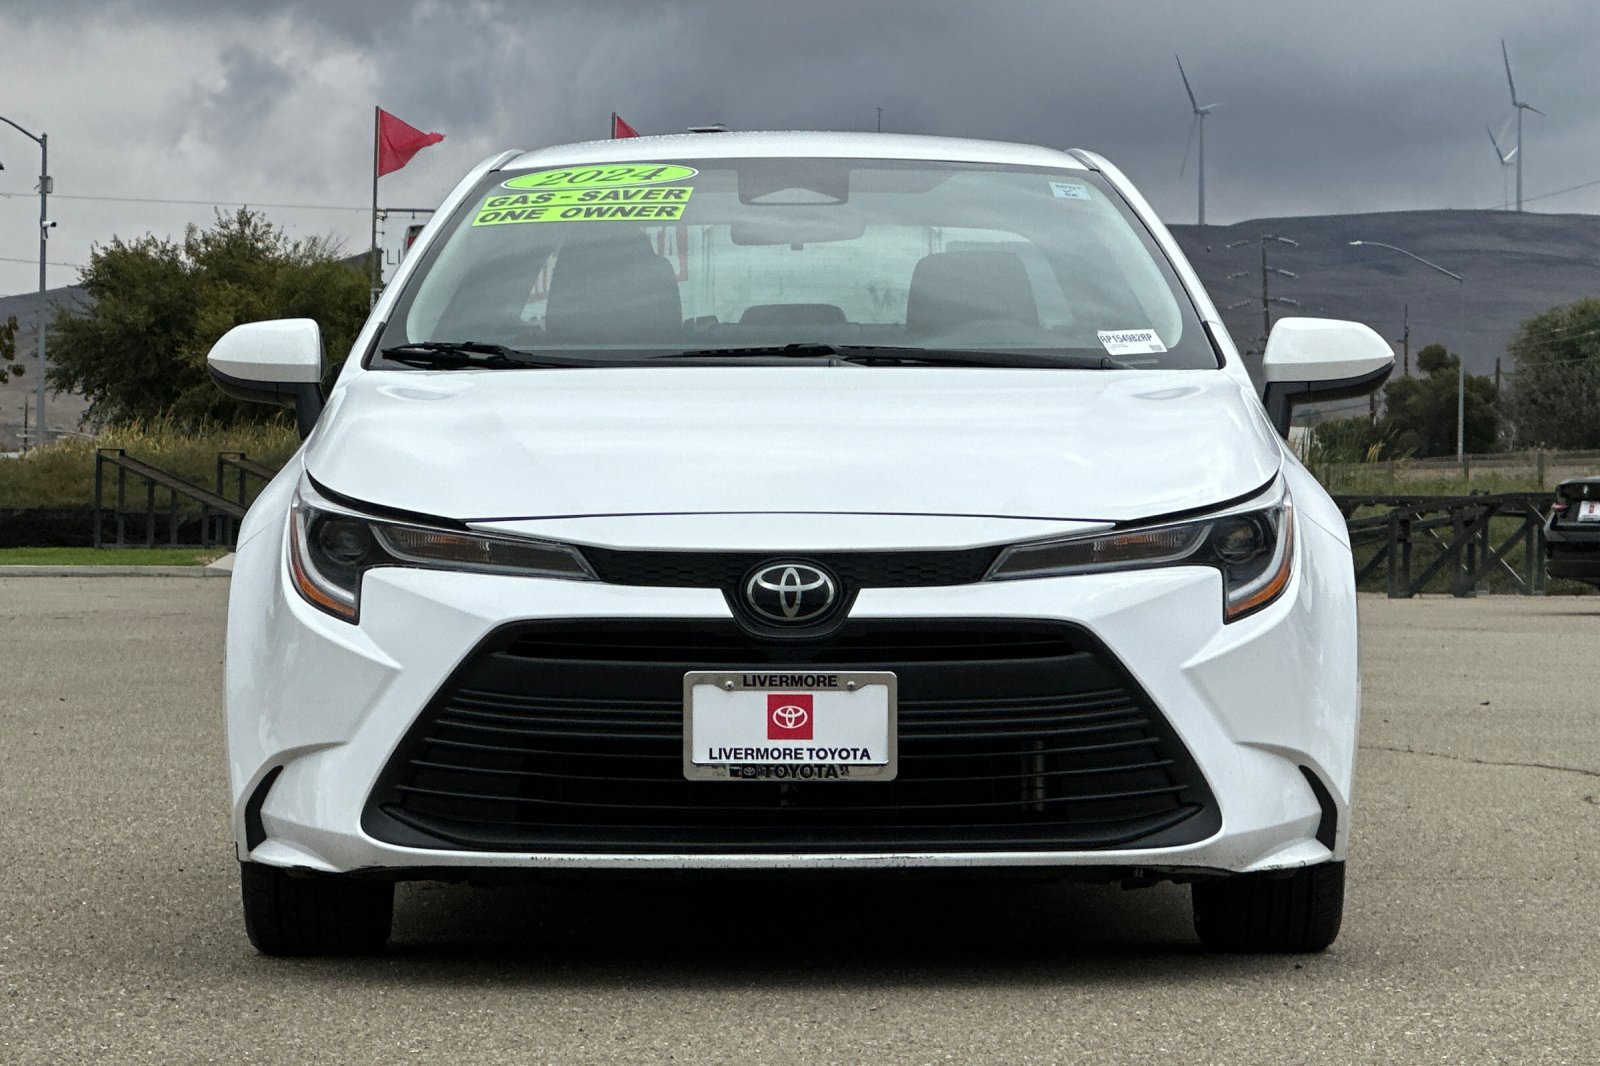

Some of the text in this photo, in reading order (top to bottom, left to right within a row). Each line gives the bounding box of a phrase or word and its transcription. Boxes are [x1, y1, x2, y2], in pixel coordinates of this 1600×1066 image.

[531, 166, 668, 188] 2024
[487, 193, 556, 208] GAS
[577, 188, 688, 202] SAVER
[478, 205, 681, 223] ONE OWNER
[742, 674, 838, 688] LIVERMORE
[708, 747, 872, 760] LIVERMORE TOYOTA
[764, 764, 839, 779] TOYOTA
